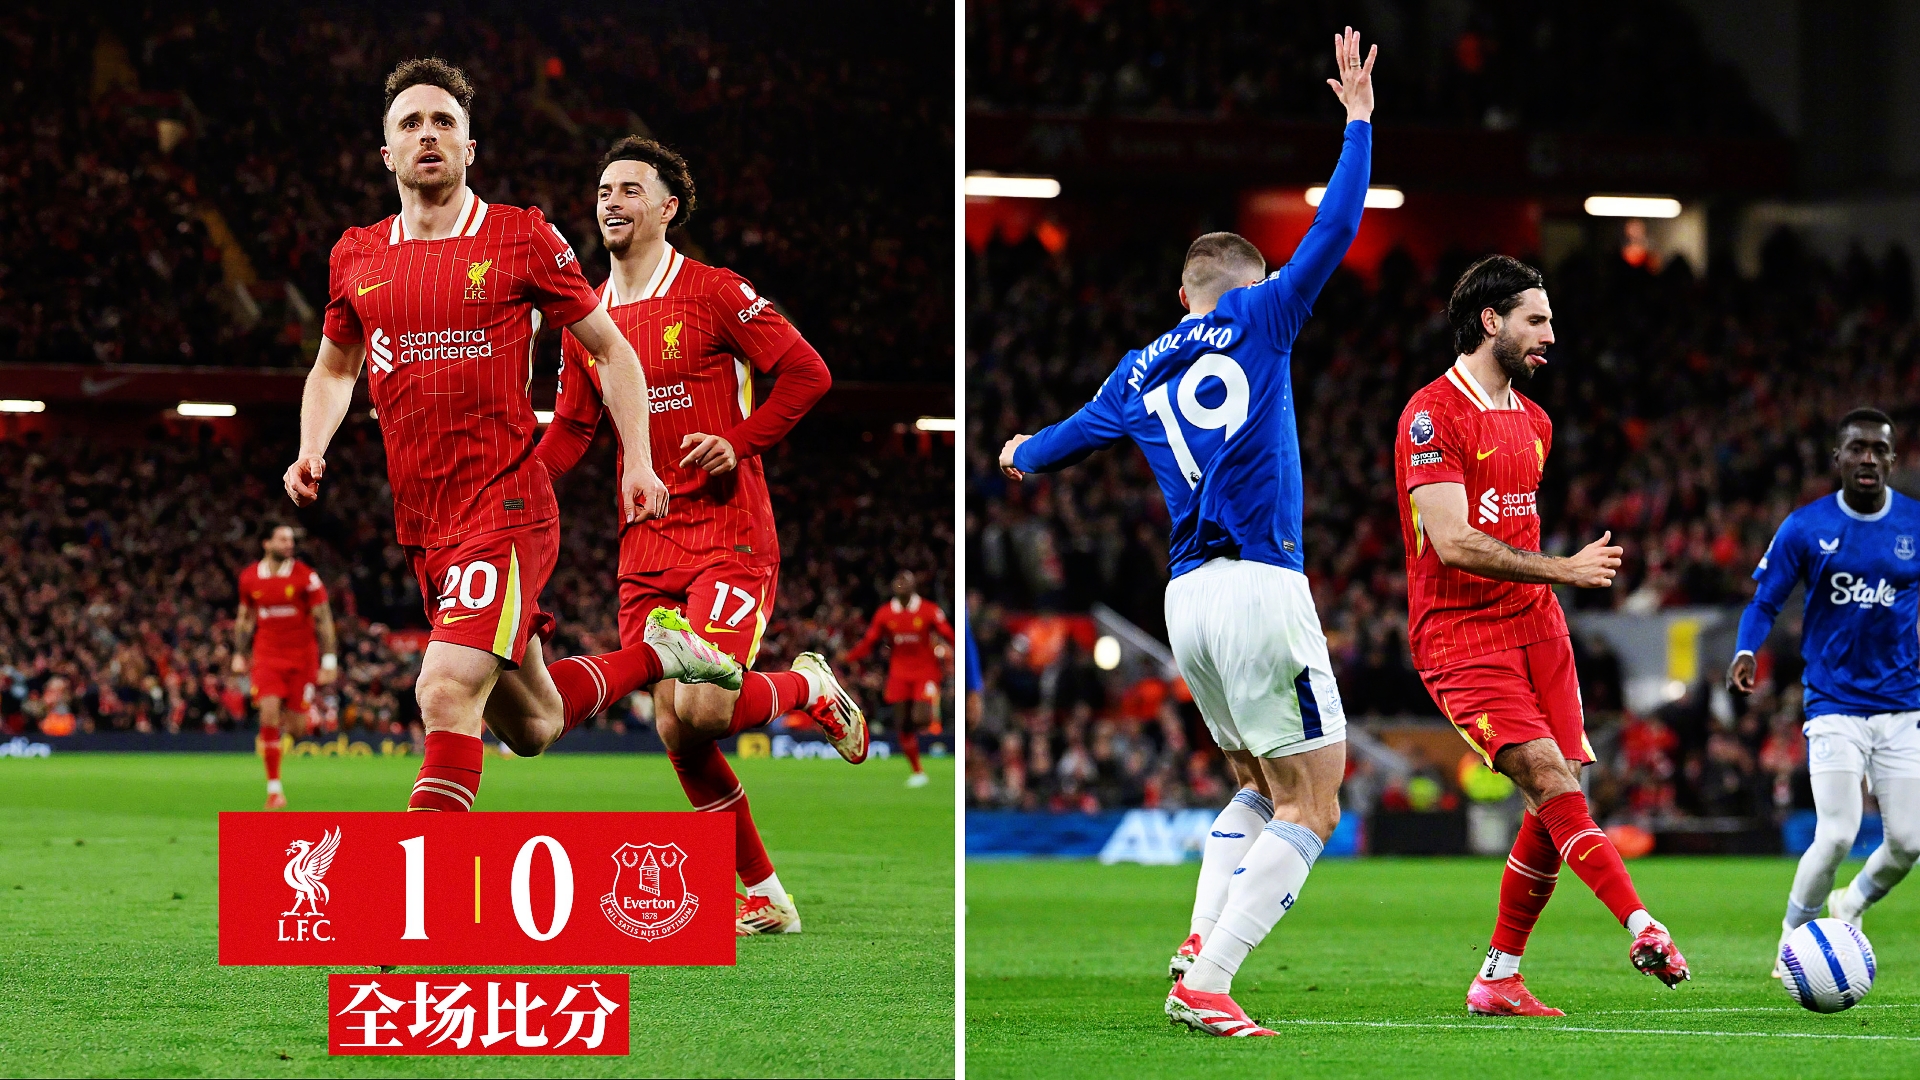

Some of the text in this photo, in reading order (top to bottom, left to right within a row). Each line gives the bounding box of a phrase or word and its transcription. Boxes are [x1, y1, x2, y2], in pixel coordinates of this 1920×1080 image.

[399, 327, 486, 347] standard
[400, 341, 492, 363] chartered
[1128, 322, 1232, 392] MYKOLNKO
[1142, 353, 1250, 491] 19
[436, 560, 498, 611] 20
[709, 581, 756, 628] 17
[1830, 572, 1896, 607] Stake
